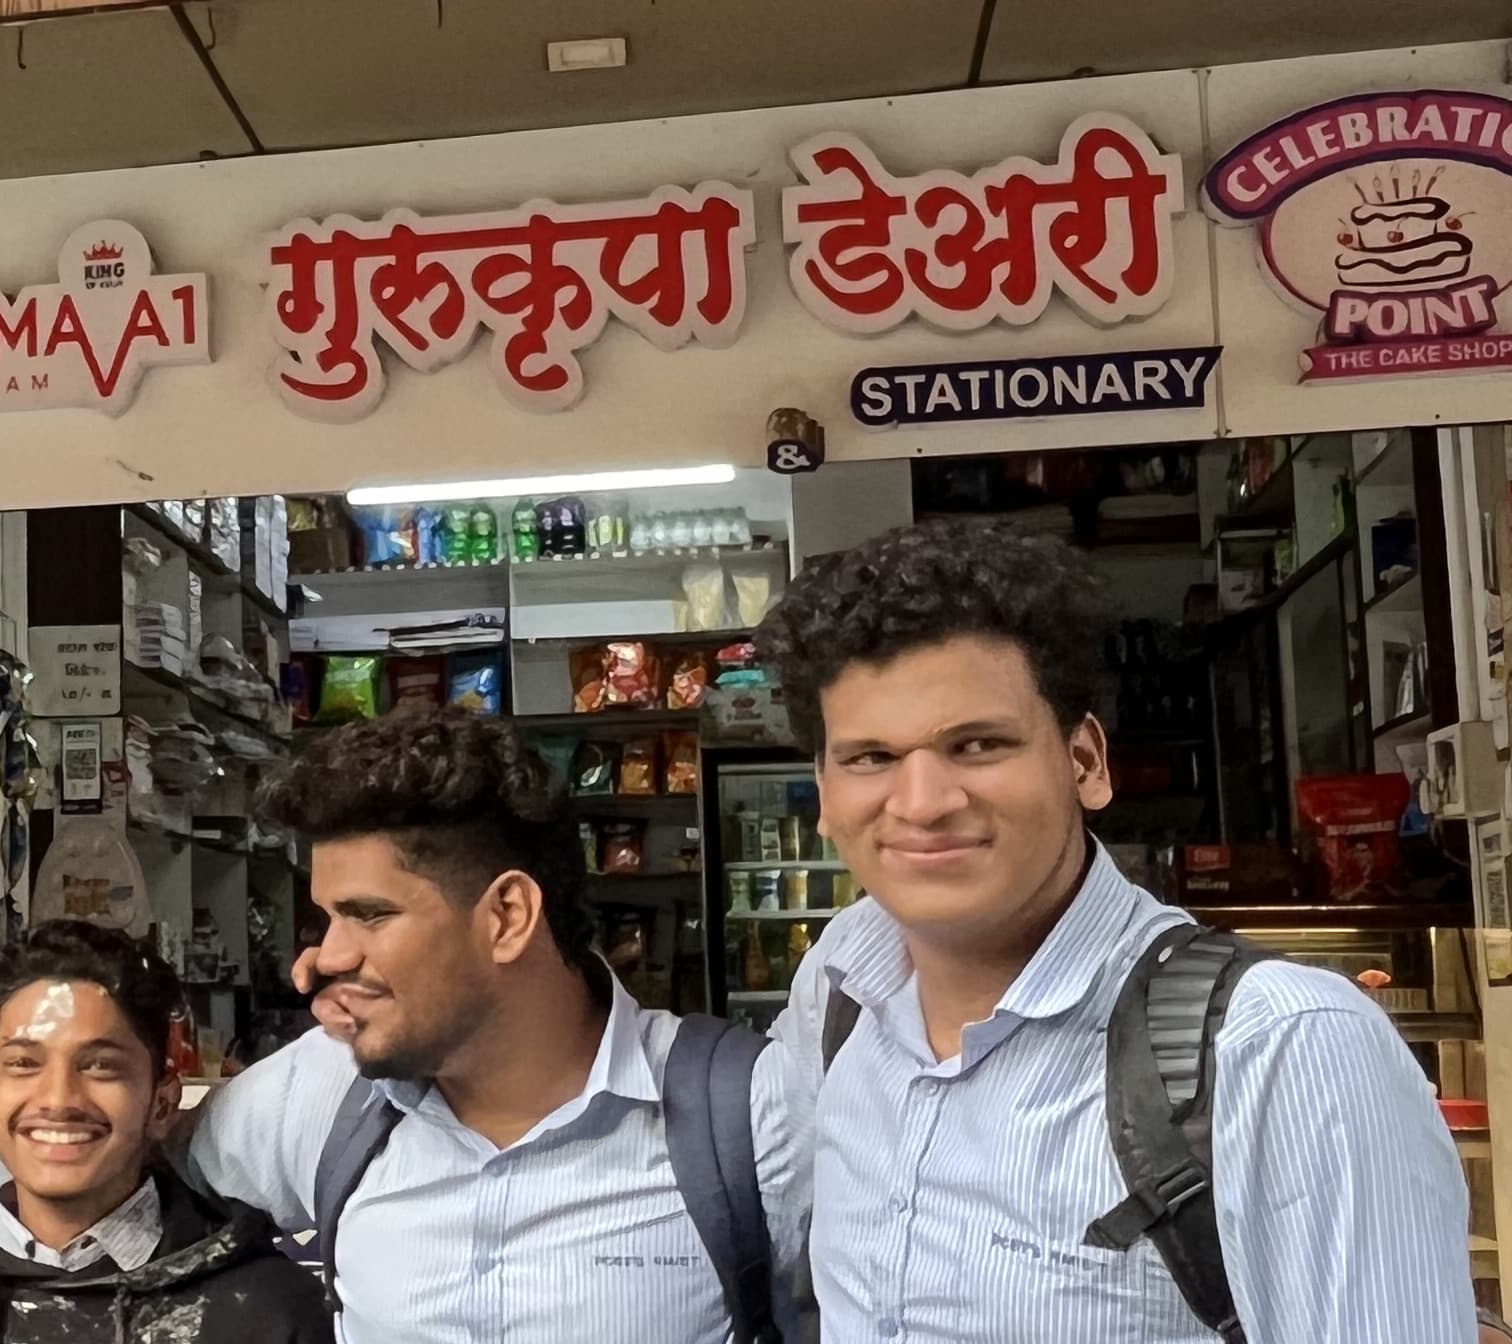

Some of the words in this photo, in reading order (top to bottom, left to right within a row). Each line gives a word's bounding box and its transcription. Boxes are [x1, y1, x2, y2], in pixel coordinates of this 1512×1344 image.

[798, 127, 1168, 315] डेअरी
[1334, 282, 1492, 336] POINT
[1327, 350, 1374, 371] THE
[1379, 344, 1441, 367] CAKE
[860, 356, 1210, 418] STATIONARY
[775, 443, 812, 470] &
